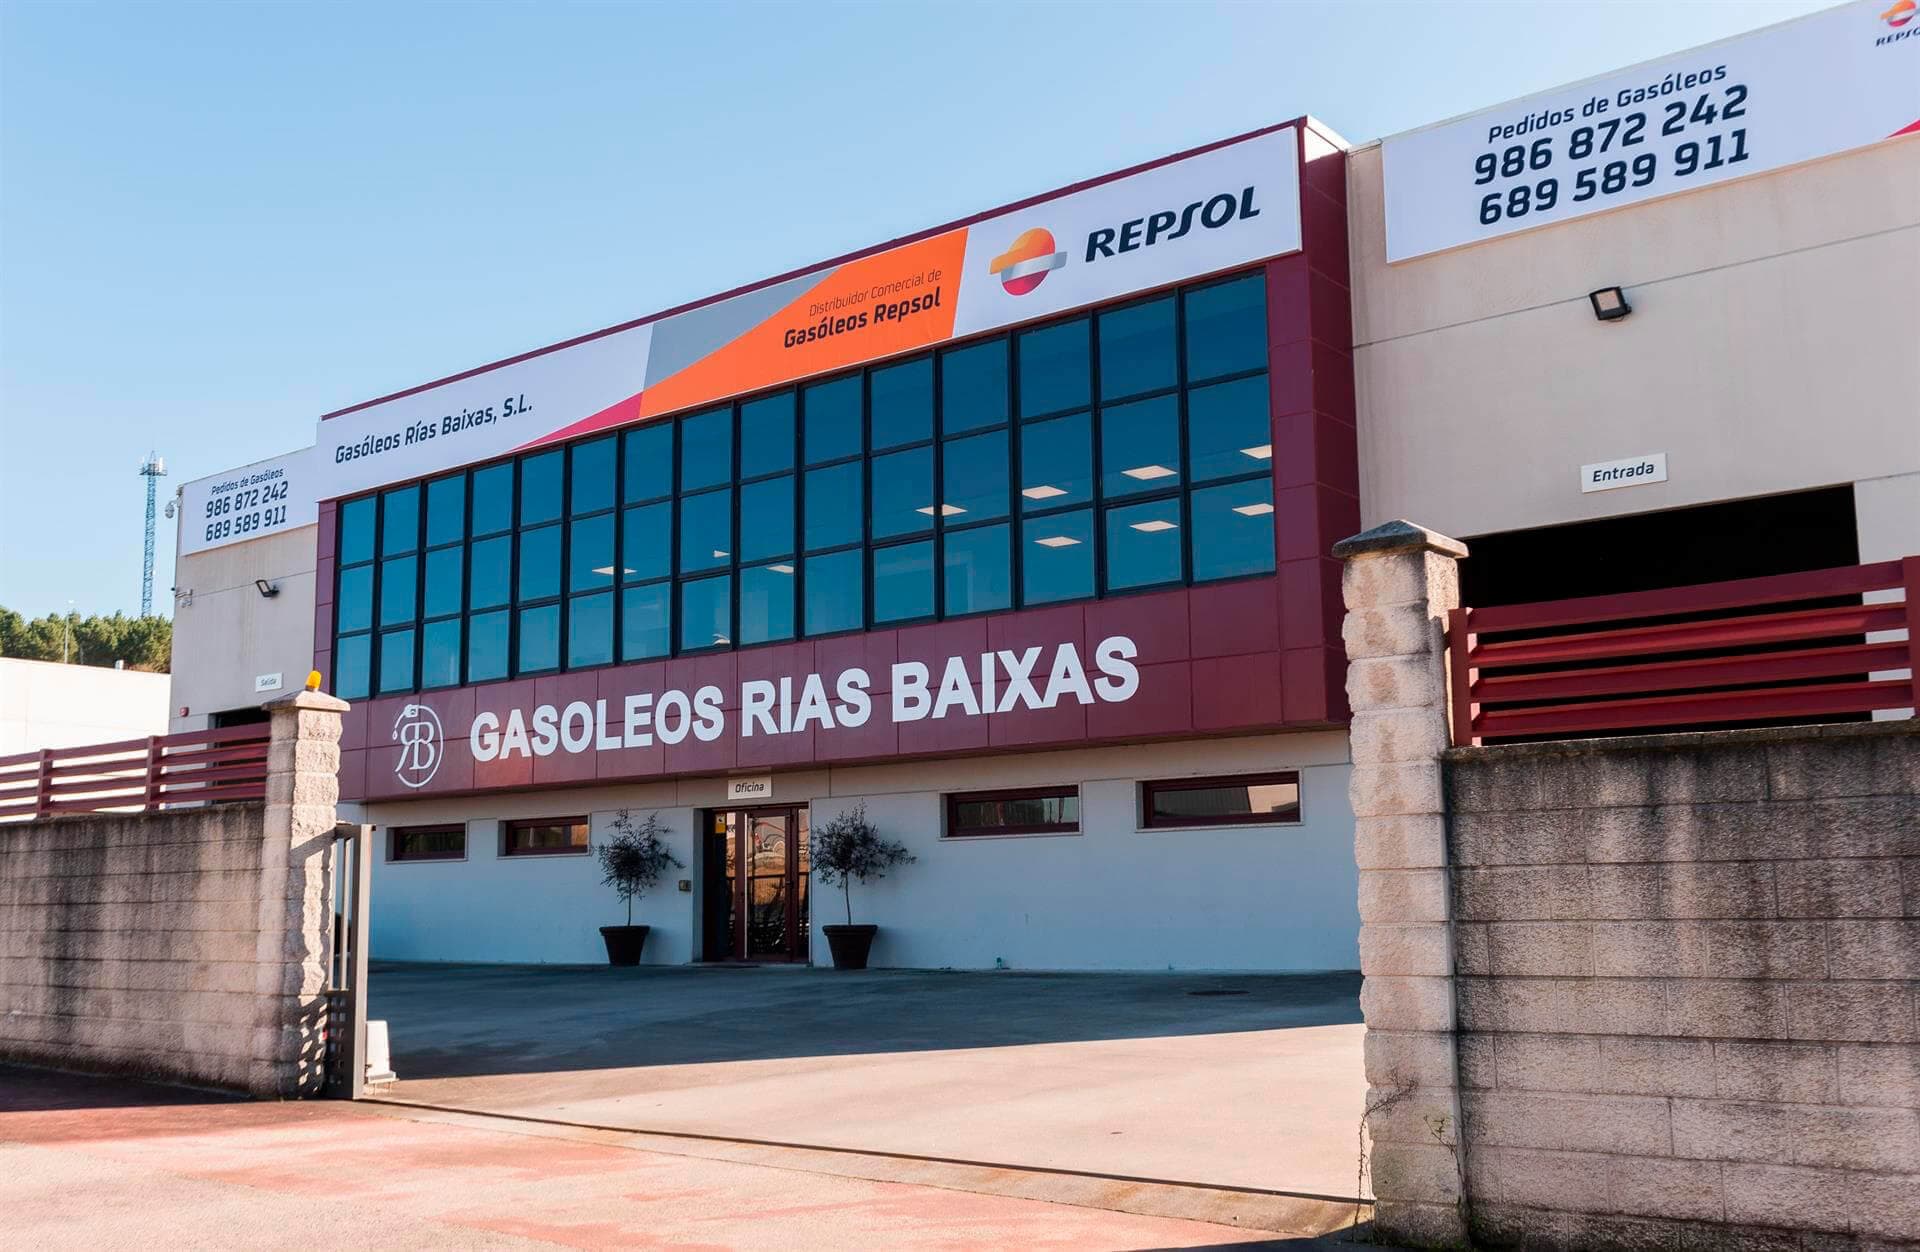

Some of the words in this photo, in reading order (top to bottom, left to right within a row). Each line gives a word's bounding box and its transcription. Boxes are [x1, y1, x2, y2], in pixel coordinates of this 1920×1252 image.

[1475, 138, 1553, 185] 986
[1568, 112, 1647, 160] 872
[1662, 84, 1748, 136] 242
[1488, 107, 1574, 144] Pedidos
[1582, 97, 1609, 117] de
[1617, 65, 1727, 108] Gasóleos
[1480, 178, 1558, 225] 689
[1572, 153, 1657, 201] 589
[1674, 128, 1749, 176] 911
[1084, 185, 1260, 263] REPSOL
[784, 311, 868, 348] Gasóleos
[874, 286, 941, 323] Repsol
[809, 290, 869, 317] Distribuidor
[871, 272, 924, 299] Comercial
[927, 269, 942, 283] de
[335, 433, 401, 464] Gasóleos
[405, 420, 437, 446] Rías
[441, 407, 497, 435] Baixas,
[502, 394, 533, 418] S.L.
[206, 496, 231, 518] 986
[234, 489, 259, 511] 872
[262, 480, 288, 503] 242
[211, 482, 238, 495] Pedidos
[240, 477, 248, 487] de
[250, 468, 284, 484] Gasóleos
[1592, 462, 1655, 482] Entrada
[205, 519, 231, 541] 689
[234, 512, 260, 534] 589
[264, 505, 286, 527] 911
[469, 685, 725, 762] GASOLEOS
[741, 667, 872, 738] RIAS
[891, 636, 1140, 723] BAIXAS
[735, 781, 764, 793] Oficina
